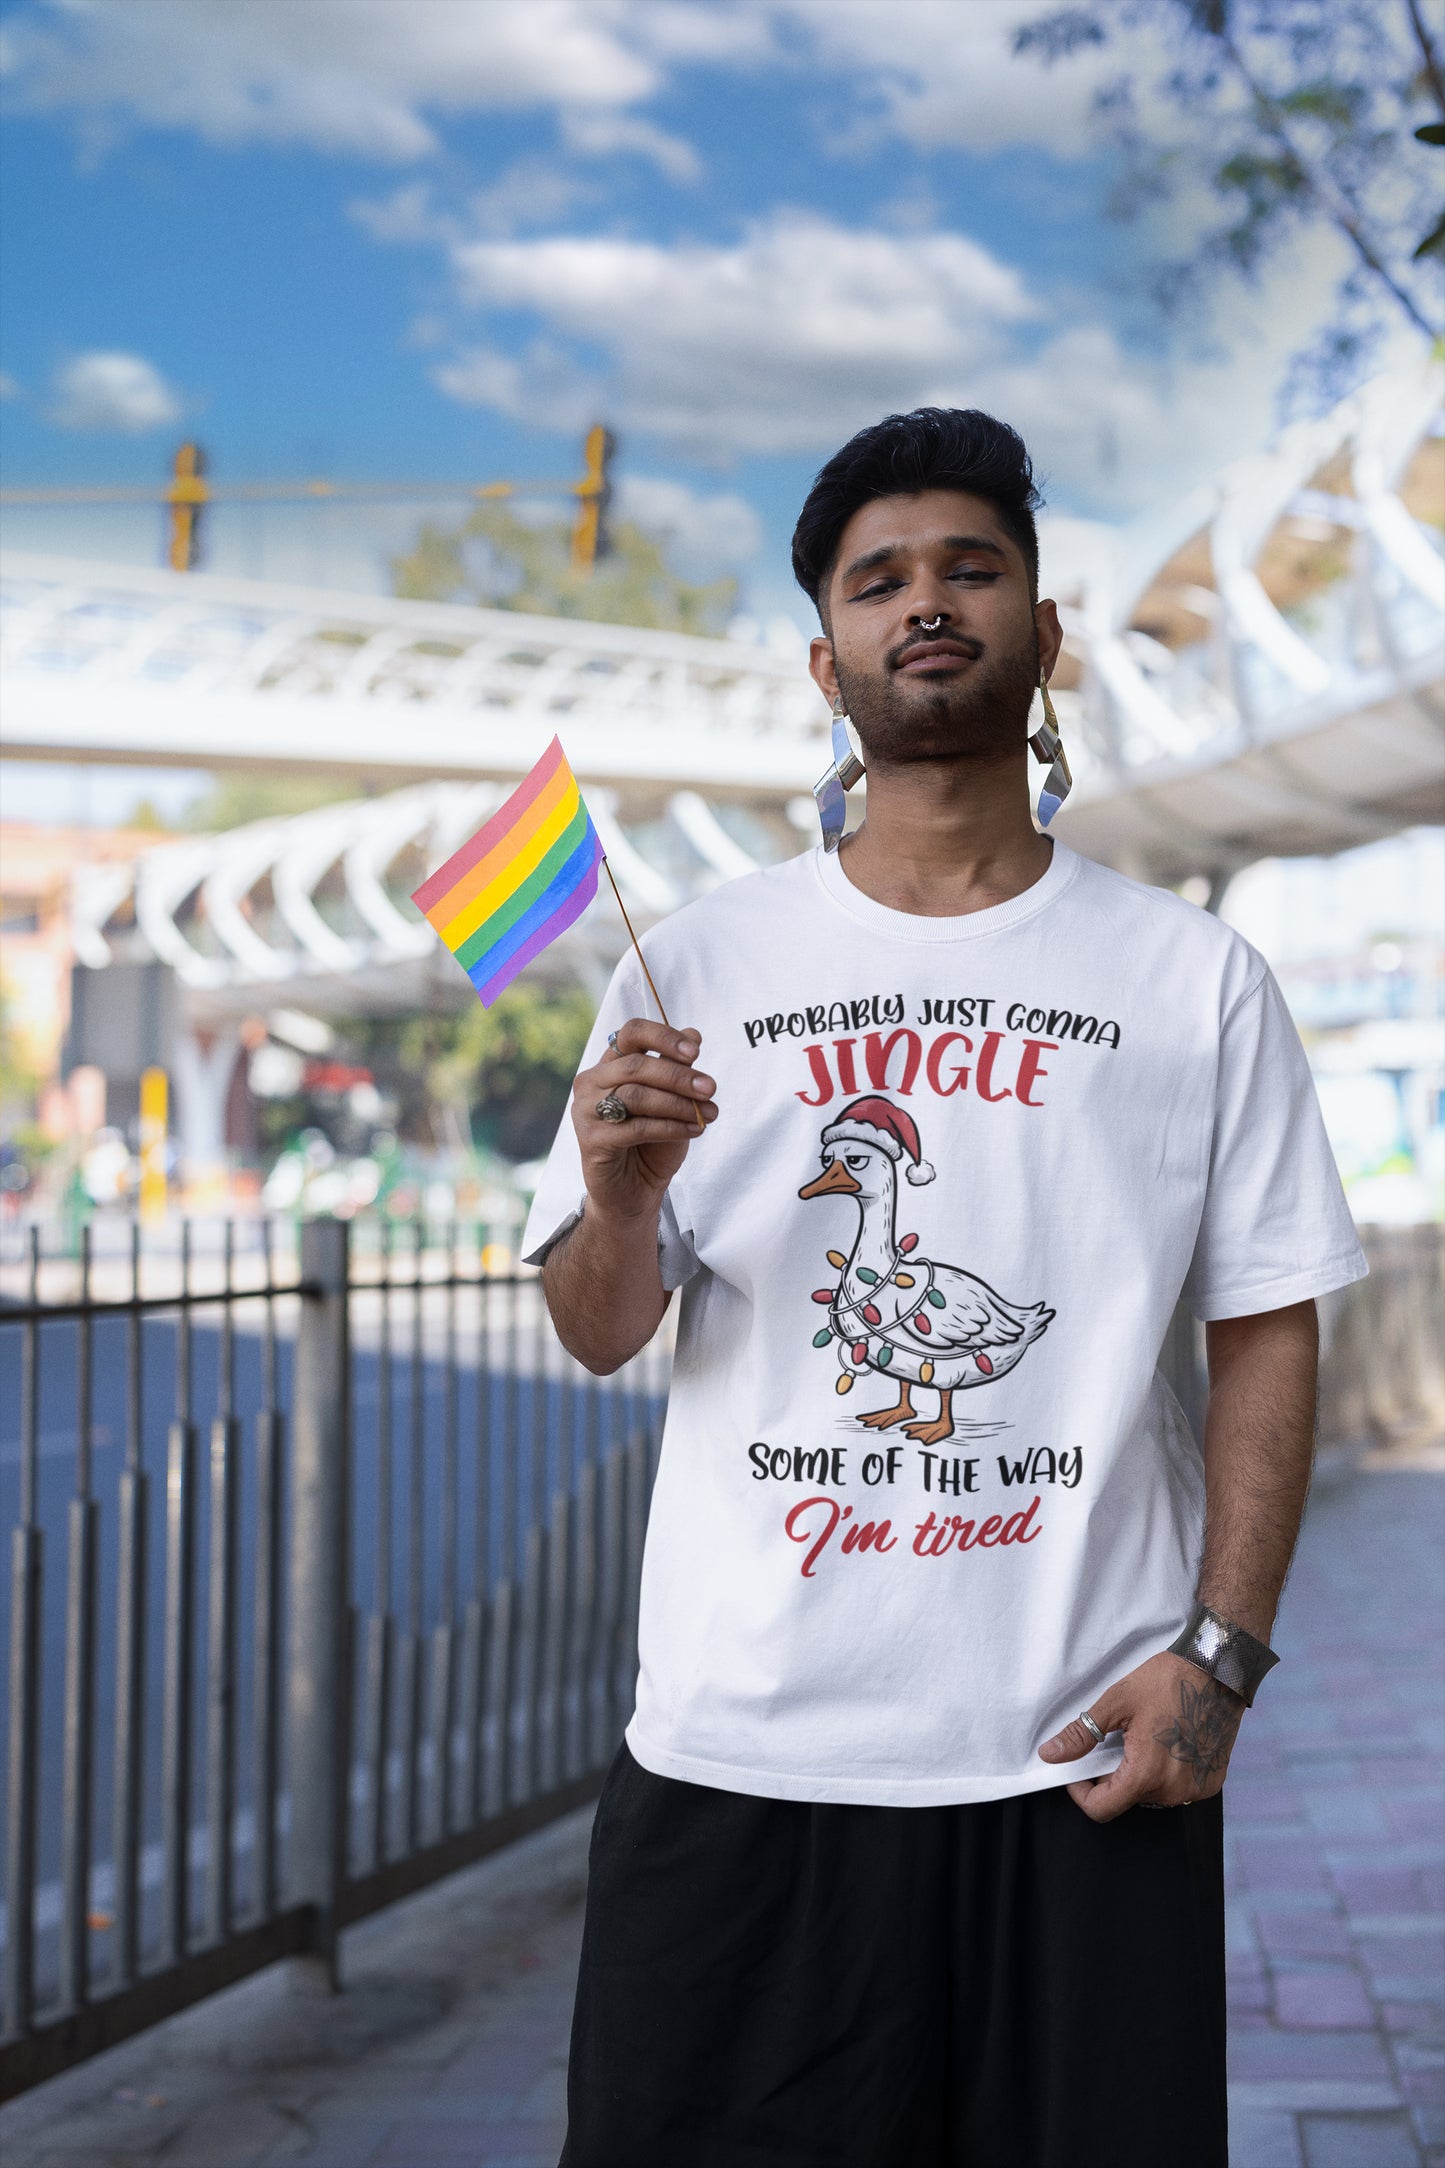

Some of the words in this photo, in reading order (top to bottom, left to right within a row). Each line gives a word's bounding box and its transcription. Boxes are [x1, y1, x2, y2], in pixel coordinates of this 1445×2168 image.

[743, 994, 904, 1048] PROBABLY
[918, 998, 995, 1027] JUST
[1005, 1003, 1121, 1049] GONNA
[794, 1028, 1060, 1106] JINGLE
[748, 1442, 847, 1486] SOME
[861, 1446, 904, 1485] OF
[917, 1450, 980, 1496] THE
[997, 1446, 1083, 1488] WAY
[785, 1496, 898, 1577] I'm
[911, 1495, 1042, 1556] tired
